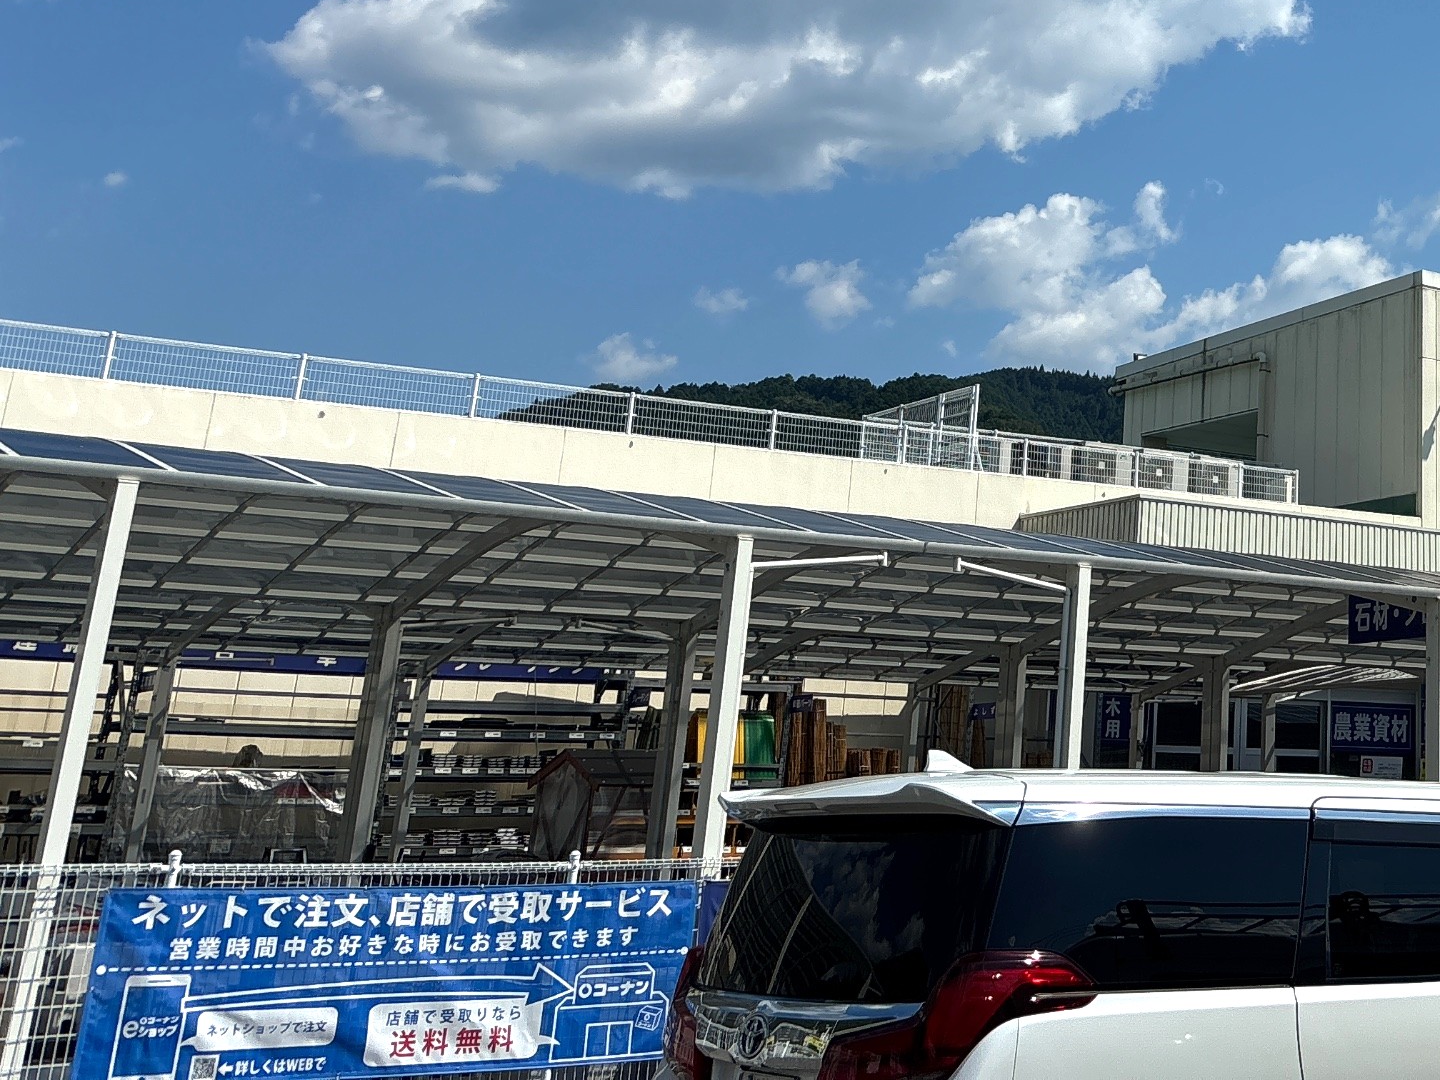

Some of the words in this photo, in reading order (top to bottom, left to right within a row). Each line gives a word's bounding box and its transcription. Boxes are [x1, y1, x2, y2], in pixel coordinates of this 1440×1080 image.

[1333, 711, 1409, 745] 農業資材
[132, 887, 672, 930] ネットで注文、店舗で受取サービス
[169, 926, 639, 961] 営業時間中お好きな時にお受取できます
[593, 980, 649, 997] コーナン
[207, 1020, 327, 1037] ネットショップで注文
[386, 1005, 521, 1026] 店舗で受取りなら
[390, 1025, 513, 1058] 送料無料
[234, 1056, 327, 1077] 詳しくはWEBで
